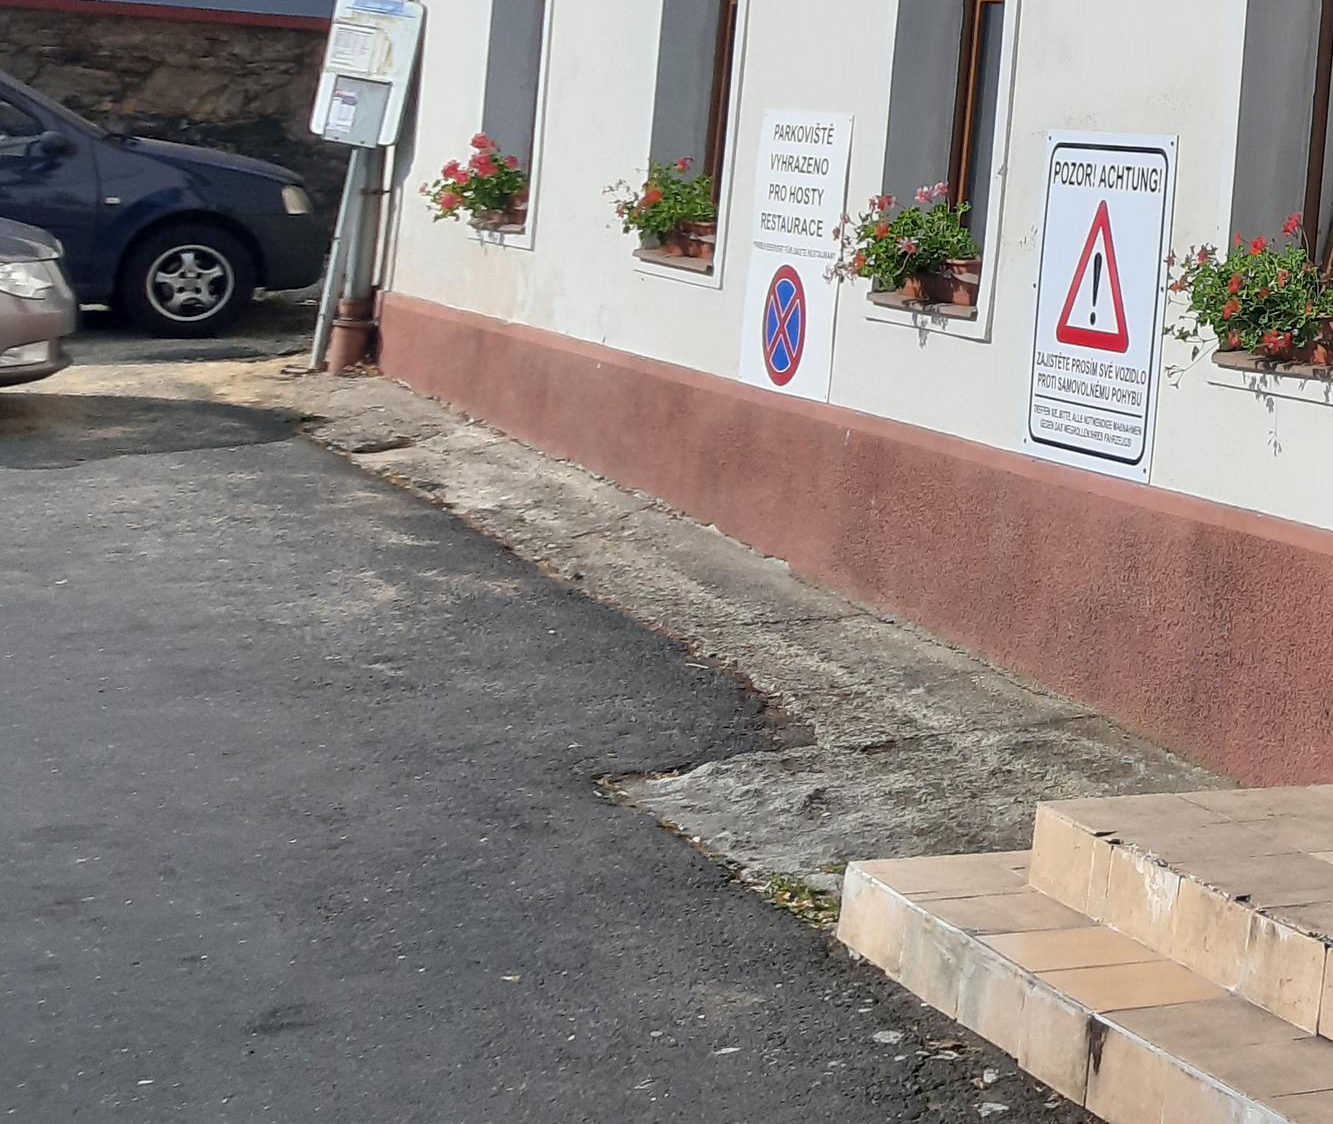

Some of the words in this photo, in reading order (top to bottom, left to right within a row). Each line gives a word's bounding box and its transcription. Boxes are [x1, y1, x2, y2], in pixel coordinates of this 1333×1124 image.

[773, 122, 835, 145] PARKOVIŠTĚ
[770, 152, 830, 176] VYHRAZENO
[1053, 160, 1097, 188] POZOR!
[1098, 164, 1163, 194] ACHTUNG!
[768, 183, 787, 202] PRO
[788, 185, 824, 207] HOSTY
[760, 212, 824, 238] RESTAURACE
[1071, 357, 1098, 377] PROSÍM
[1099, 360, 1113, 380] SVÉ
[1115, 365, 1147, 385] VOZIDLO
[1037, 372, 1057, 390] PROTI
[1057, 376, 1111, 401] SAMOVOLNÉMU
[1111, 387, 1143, 407] POHYBU
